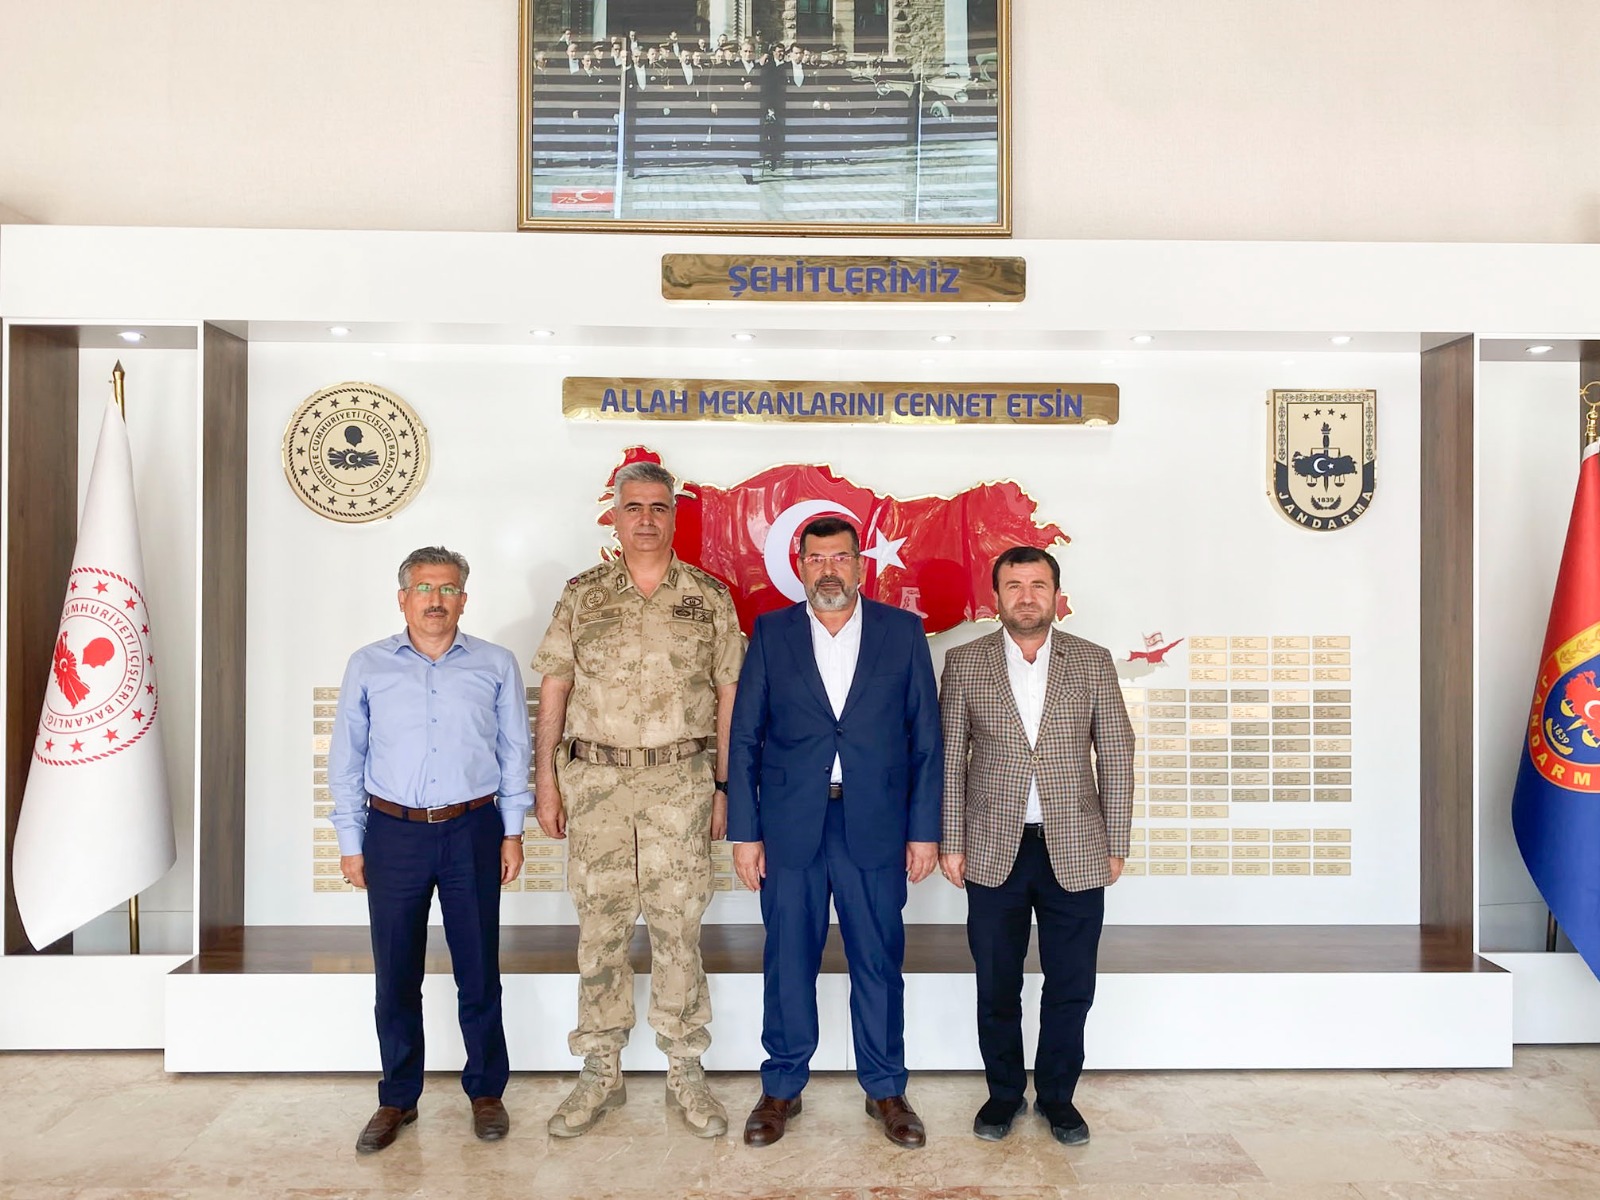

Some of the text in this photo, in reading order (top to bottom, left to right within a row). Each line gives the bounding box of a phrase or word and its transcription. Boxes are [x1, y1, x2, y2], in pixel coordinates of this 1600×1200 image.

[728, 260, 960, 298] ŞEHİTLERİMİZ
[600, 388, 1082, 418] ALLAH MEKANLARINI CENNET ETSİN
[312, 411, 396, 489] TÜRKİYE CUMHURİYETİ İÇİŞLERİ BAKANLIĞI
[1279, 491, 1373, 529] JANDARMA
[1531, 675, 1592, 786] JANDARM
[1553, 723, 1570, 744] 1839
